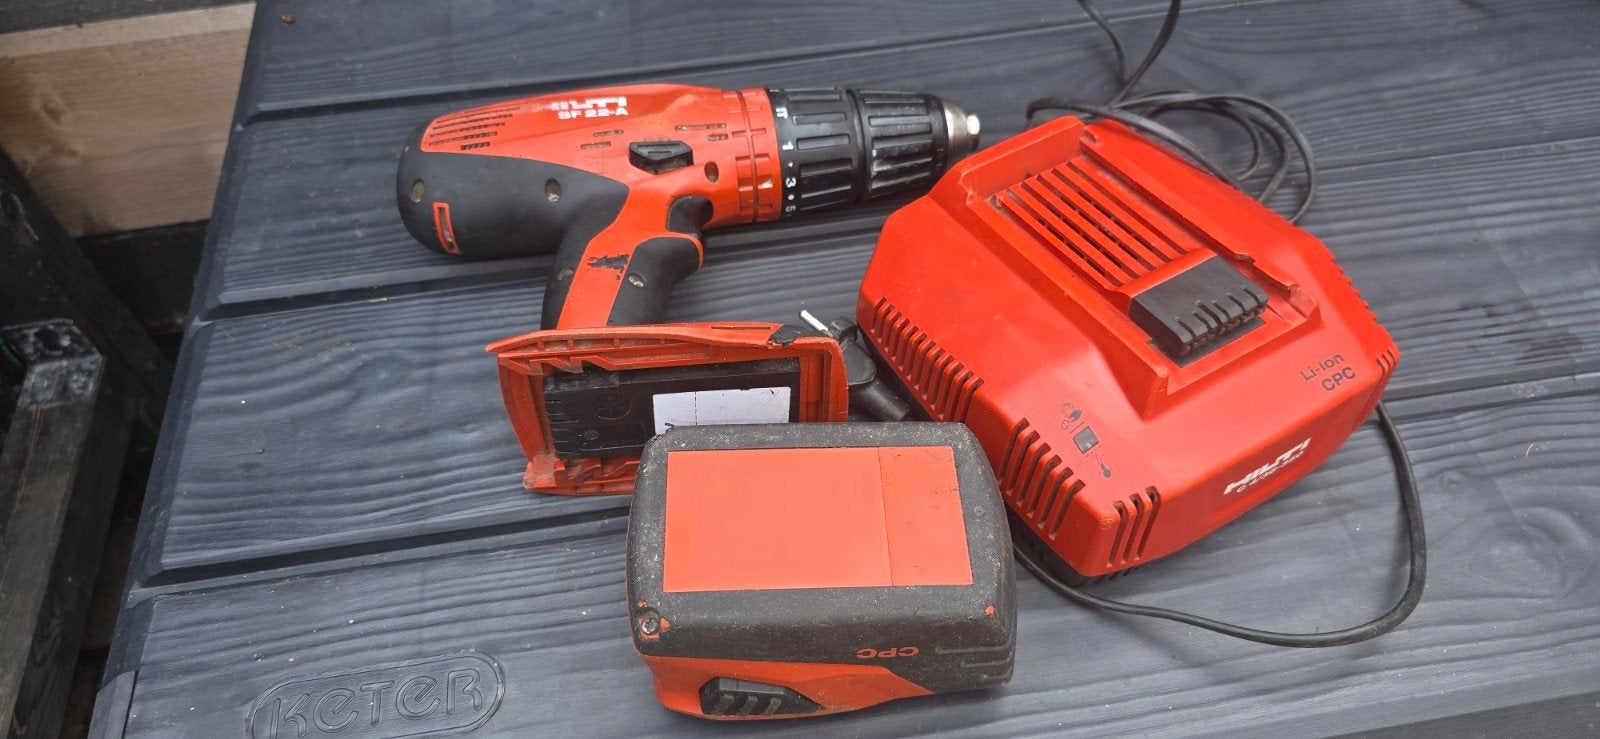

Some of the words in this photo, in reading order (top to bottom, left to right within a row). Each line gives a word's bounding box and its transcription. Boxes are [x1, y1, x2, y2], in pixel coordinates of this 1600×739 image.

[558, 109, 582, 119] SF
[585, 107, 629, 117] 22-A
[782, 141, 794, 150] 1
[785, 177, 797, 188] 3
[1322, 367, 1356, 391] CPC
[1223, 437, 1312, 495] HILTI
[856, 646, 919, 659] CPC
